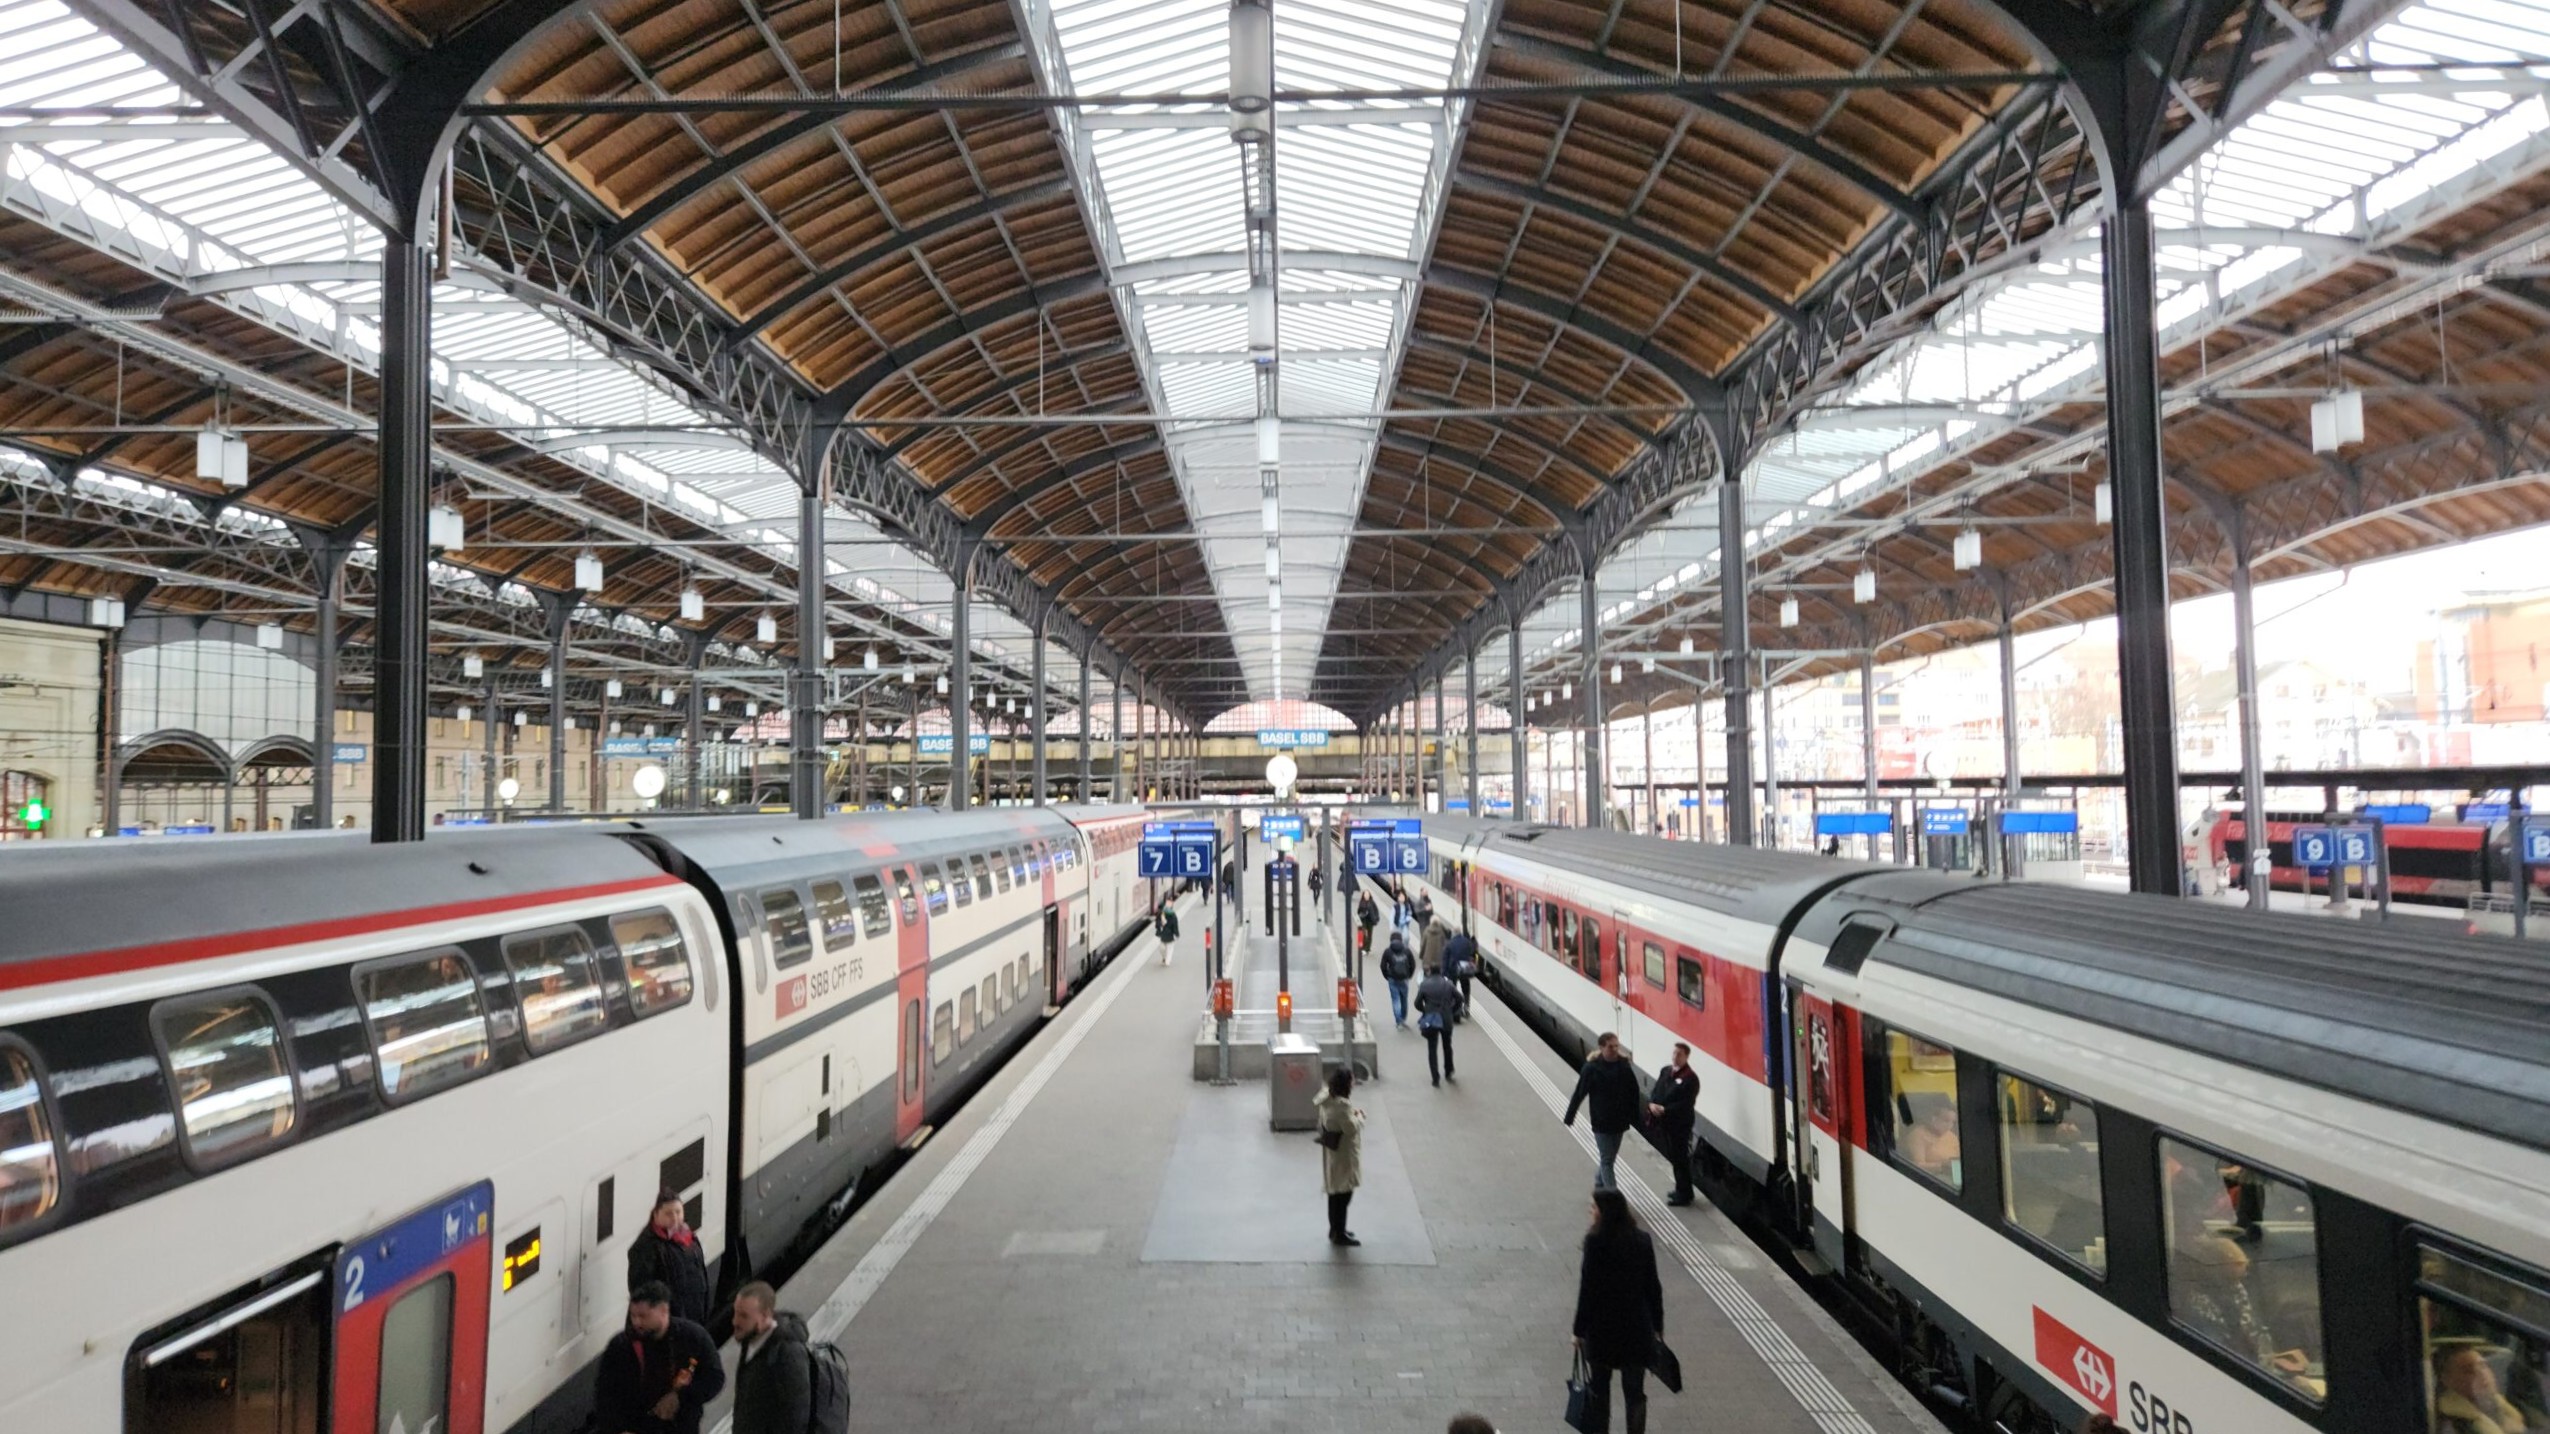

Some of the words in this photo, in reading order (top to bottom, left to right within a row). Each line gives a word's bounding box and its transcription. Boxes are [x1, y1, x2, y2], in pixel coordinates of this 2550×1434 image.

[922, 739, 954, 751] BASE
[969, 738, 987, 750] BB
[1260, 732, 1299, 745] BASEL
[1300, 732, 1325, 745] SBB
[1364, 848, 1380, 869] B
[1402, 848, 1418, 869] 8
[2306, 838, 2324, 862] 9
[2346, 838, 2365, 861] B
[1149, 852, 1164, 872] 7
[1186, 851, 1202, 872] B
[810, 969, 829, 999] SBB
[831, 962, 847, 991] CFF
[849, 957, 863, 984] FFS
[344, 1255, 365, 1313] 2
